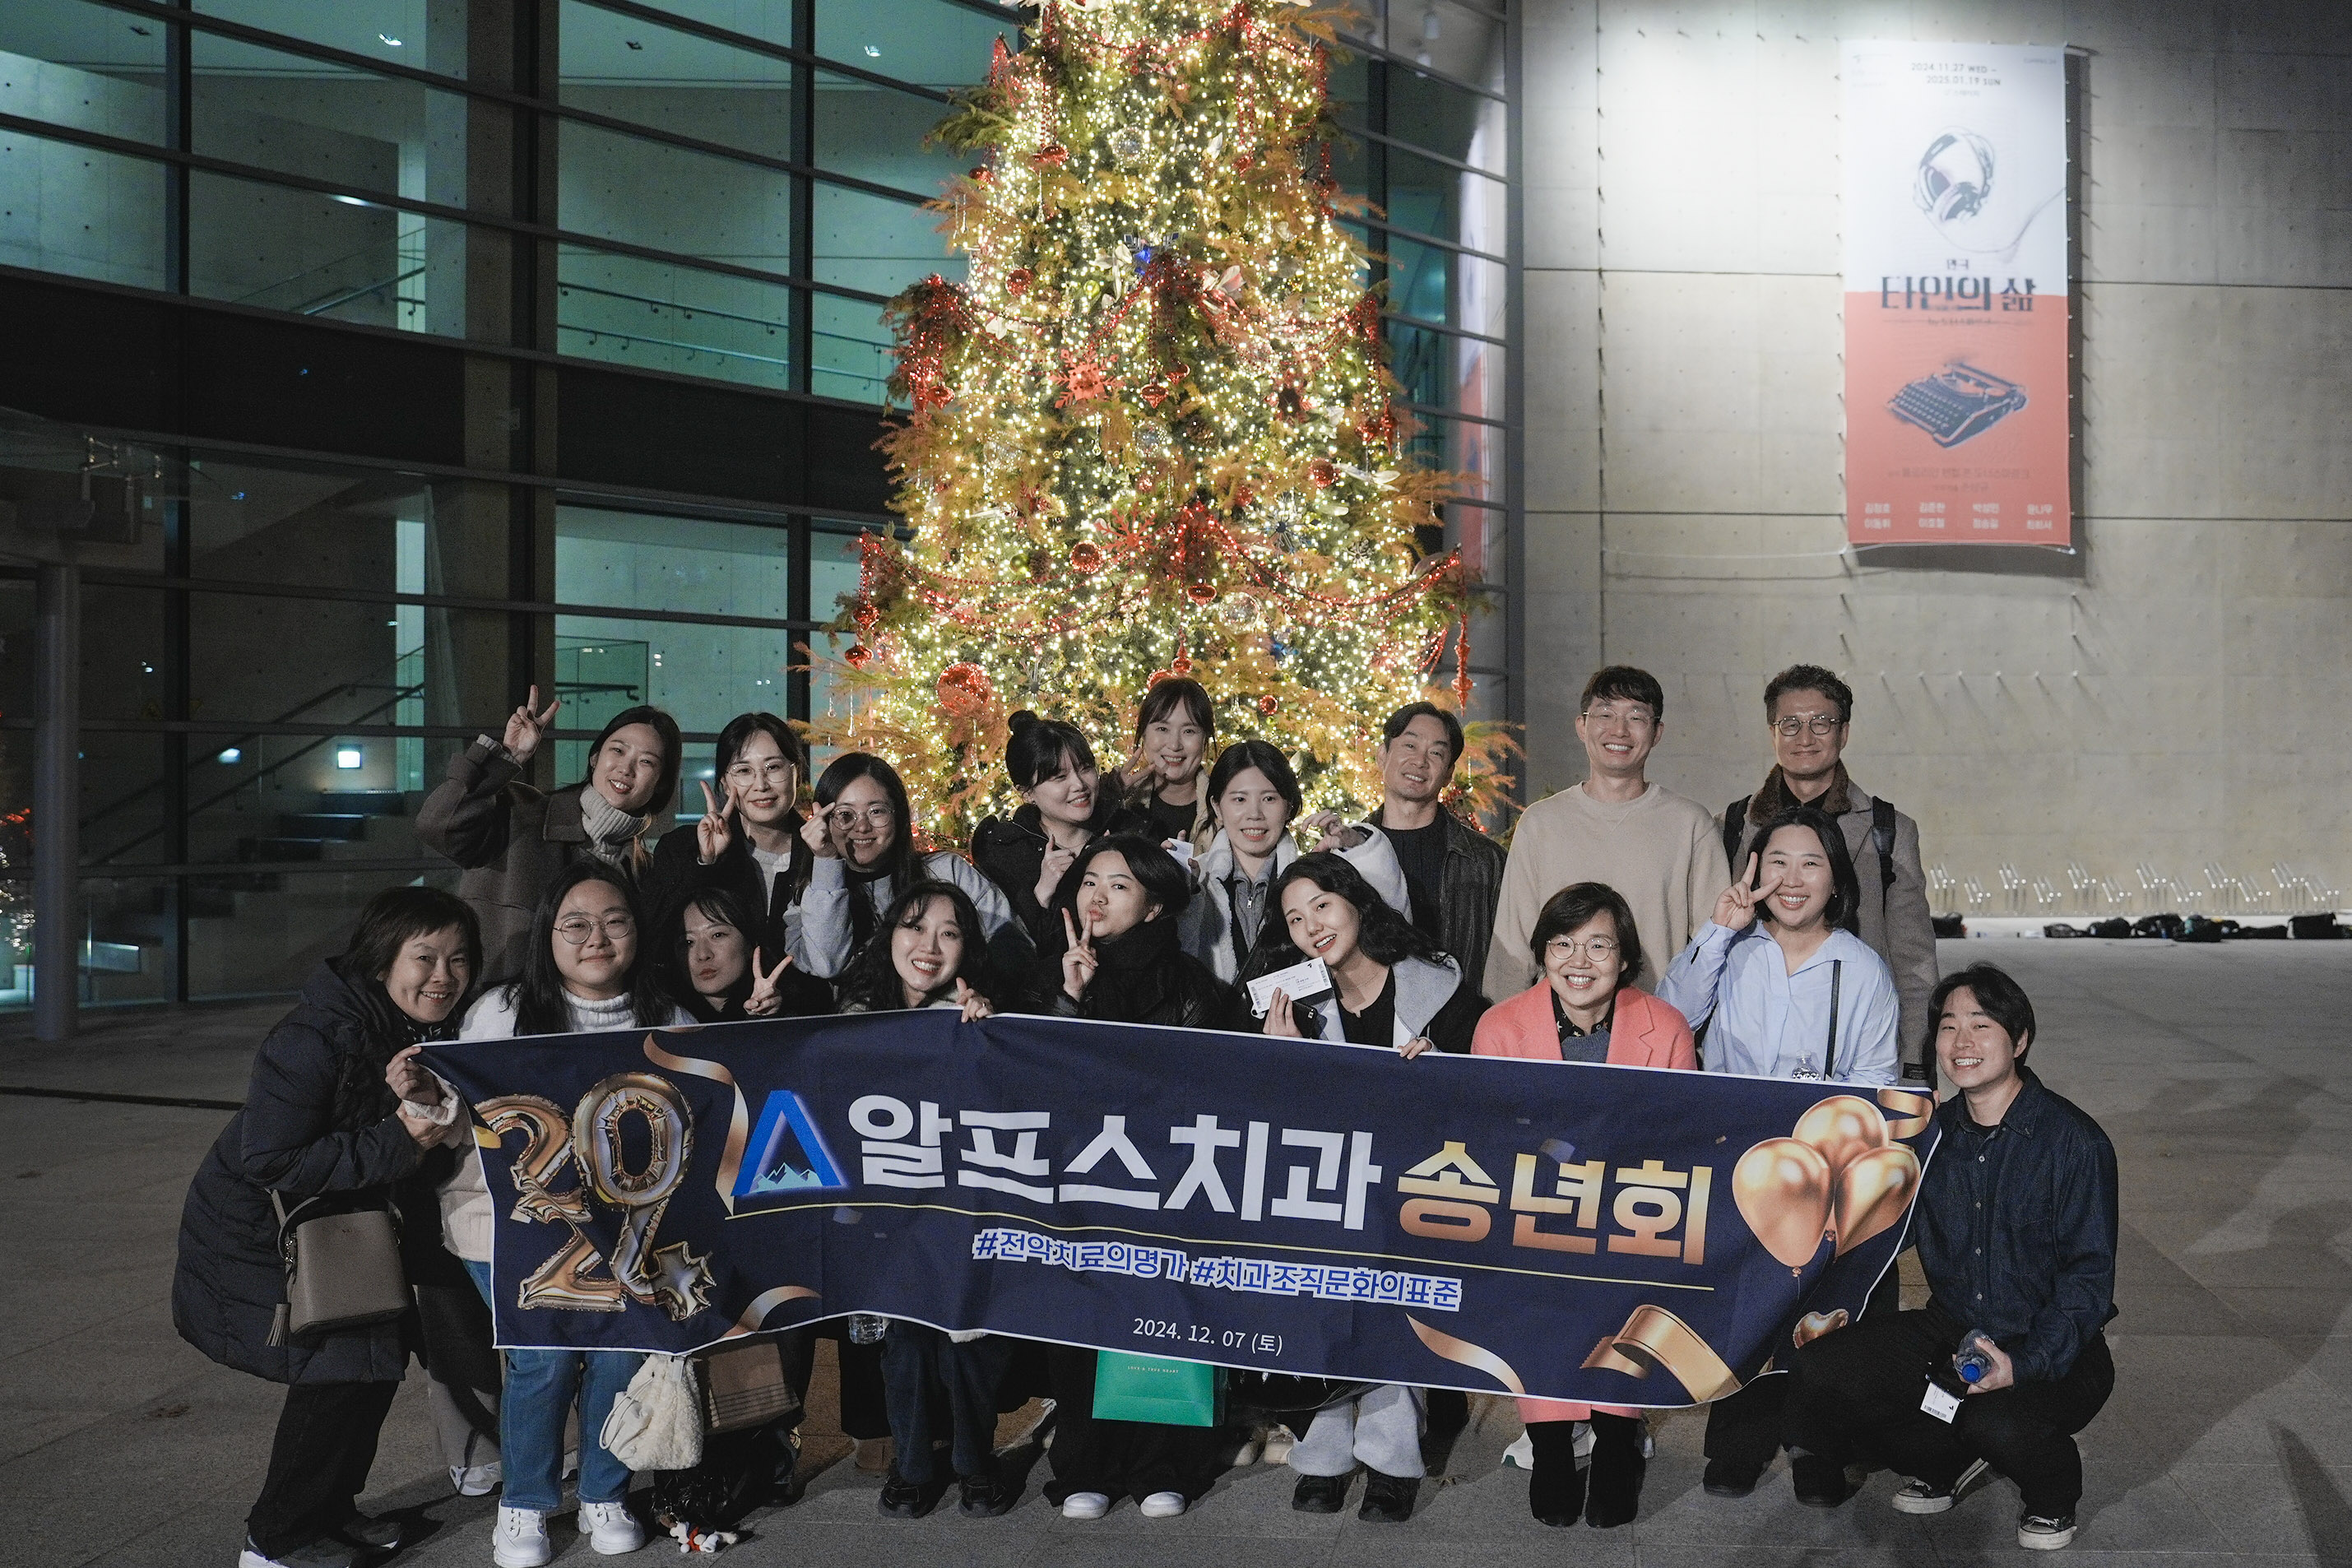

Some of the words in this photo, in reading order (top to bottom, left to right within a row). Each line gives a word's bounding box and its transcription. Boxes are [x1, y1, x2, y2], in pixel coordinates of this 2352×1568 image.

[1968, 65, 1988, 73] WED
[1983, 78, 2002, 86] SUN
[1881, 276, 1991, 311] 타인의
[2000, 278, 2036, 312] 삶
[848, 1095, 1381, 1230] 알프스치과
[1397, 1140, 1713, 1265] 송년회
[1133, 1318, 1181, 1340] 2024.
[1188, 1324, 1215, 1344] 12.
[1222, 1330, 1246, 1348] 07
[1251, 1333, 1283, 1357] (토)
